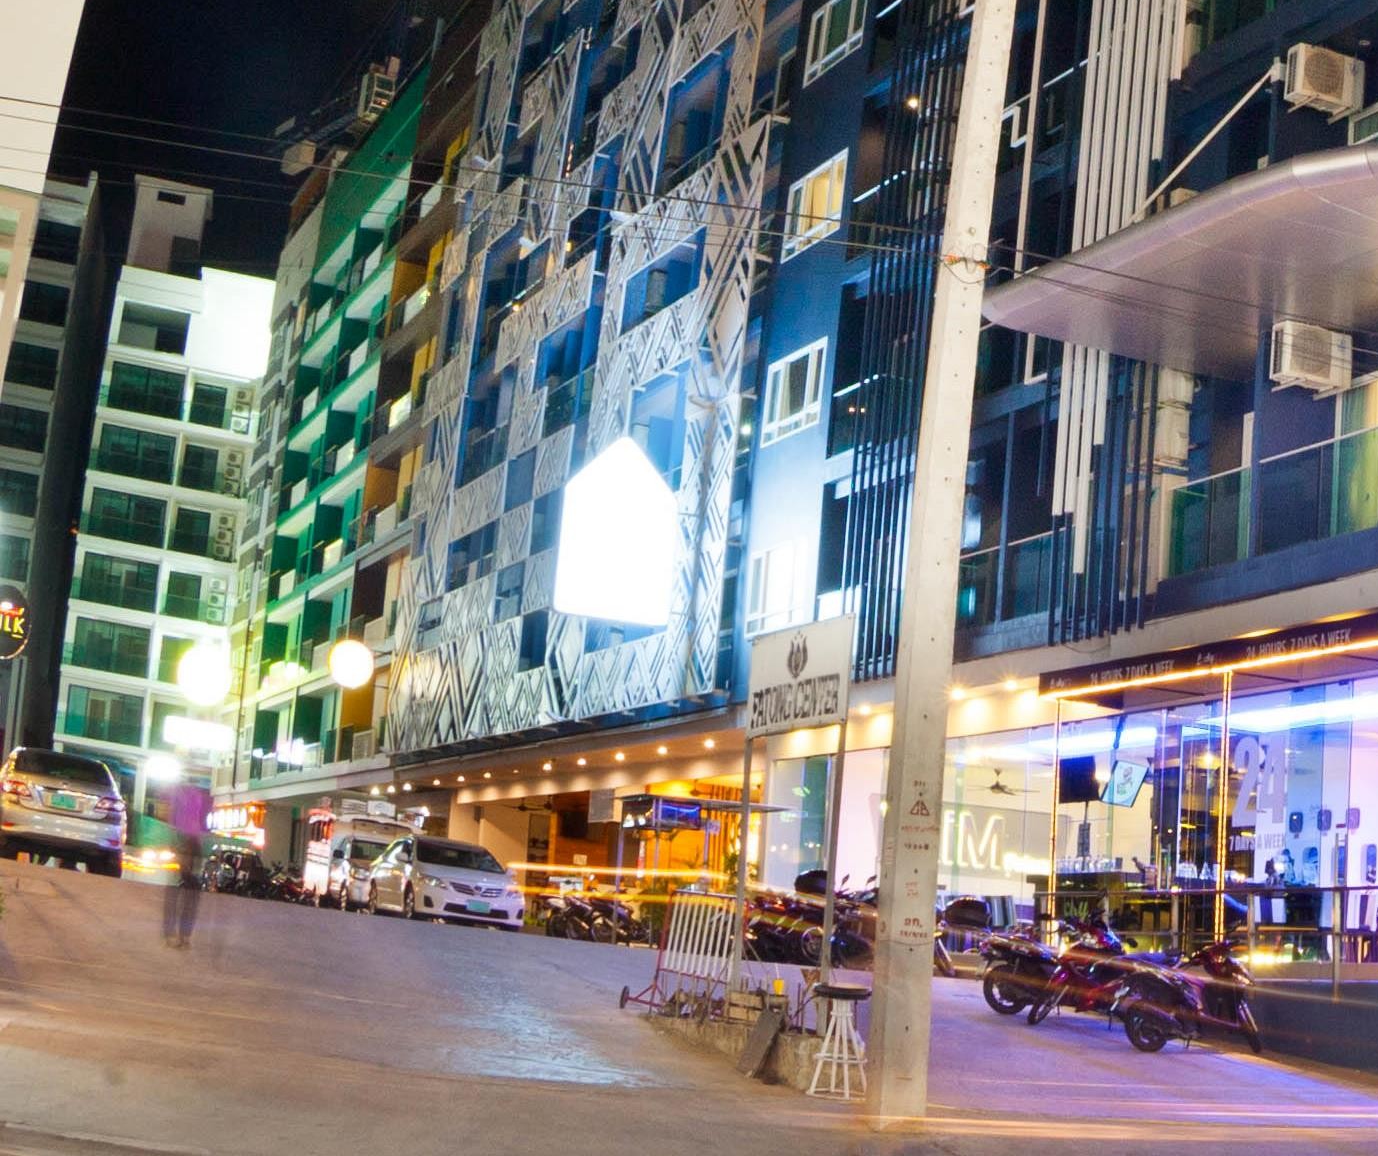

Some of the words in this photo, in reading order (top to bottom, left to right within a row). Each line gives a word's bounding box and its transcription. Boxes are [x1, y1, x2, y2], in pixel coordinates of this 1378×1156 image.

[0, 613, 25, 635] LK
[750, 682, 793, 730] PATONG
[793, 672, 841, 720] CENTER
[1231, 735, 1286, 828] 24
